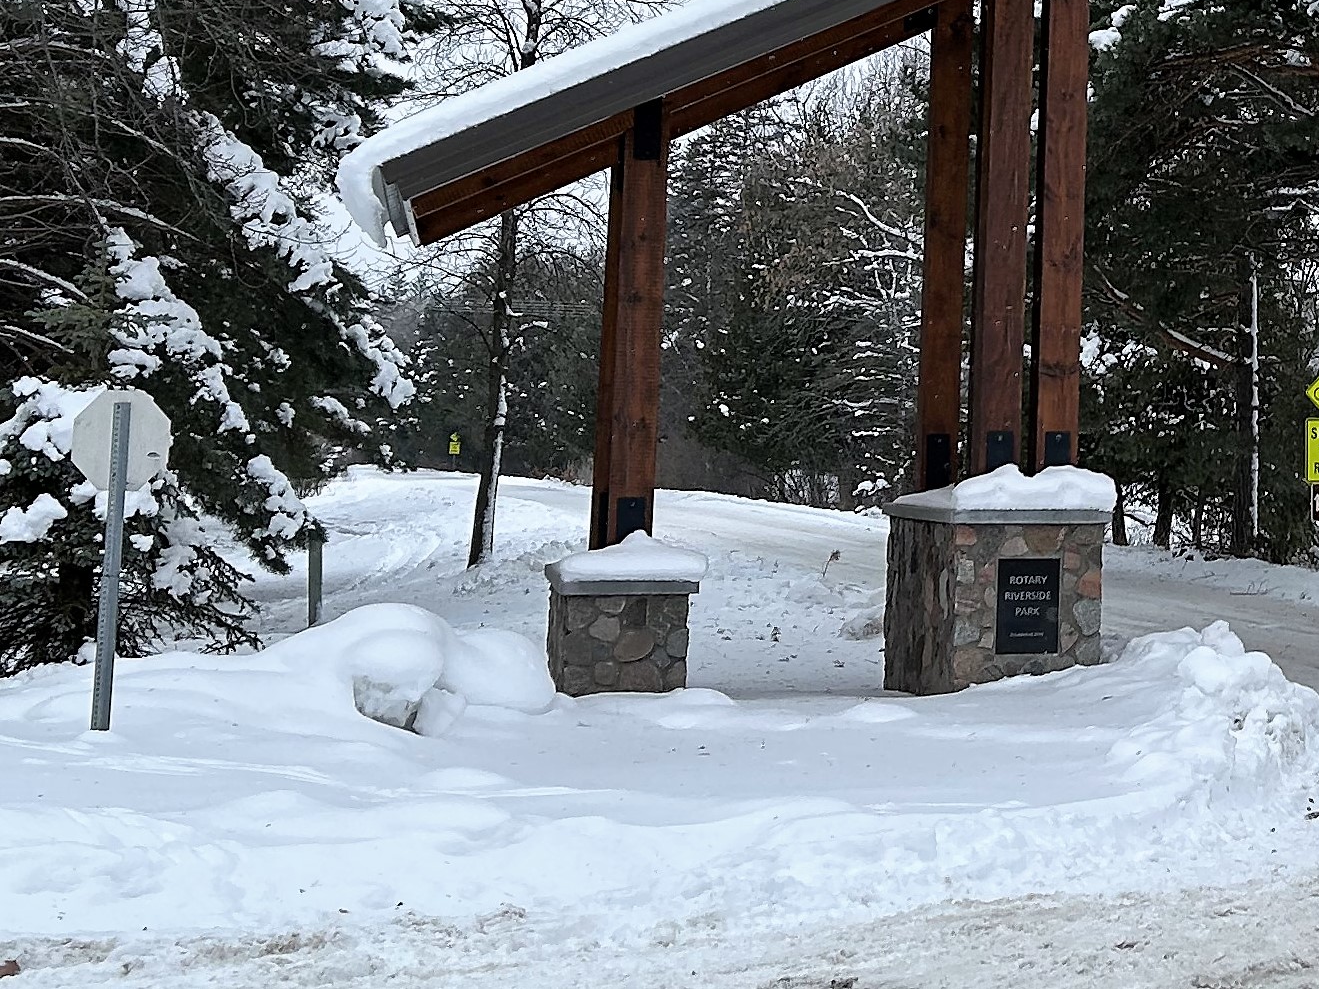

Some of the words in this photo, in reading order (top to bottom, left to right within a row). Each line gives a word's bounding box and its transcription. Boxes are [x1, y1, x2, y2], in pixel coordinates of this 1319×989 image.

[1009, 575, 1048, 585] ROTARY
[1004, 591, 1052, 601] RIVERSIDE
[1014, 606, 1040, 617] PARK
